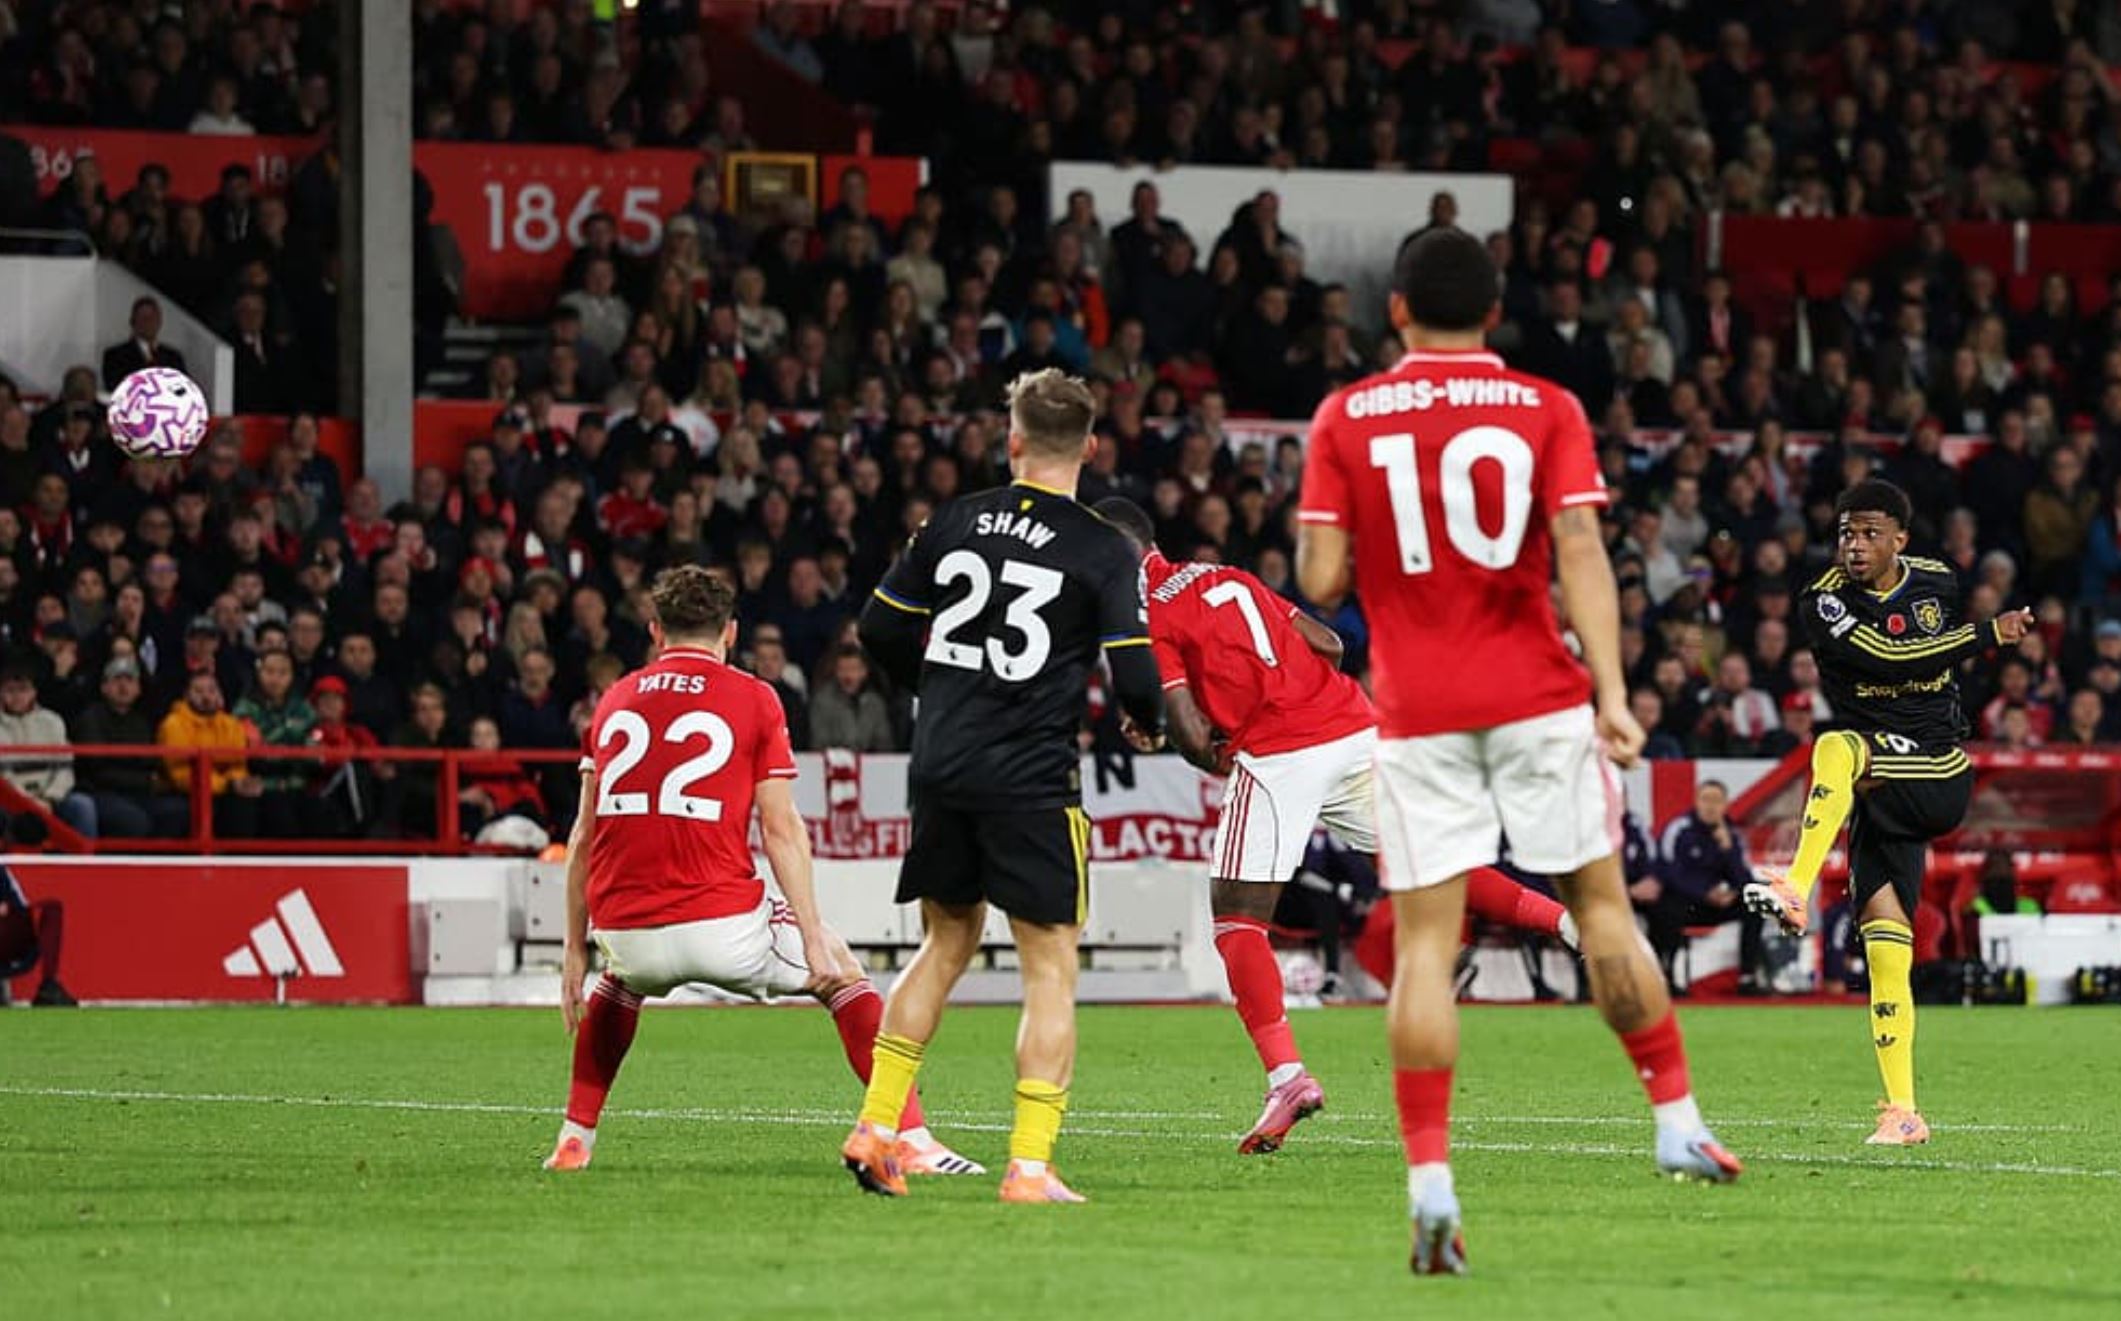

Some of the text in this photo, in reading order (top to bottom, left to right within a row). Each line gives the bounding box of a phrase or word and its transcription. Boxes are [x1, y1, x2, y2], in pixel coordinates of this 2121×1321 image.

[484, 184, 663, 254] 1865
[1346, 379, 1541, 418] GIBBS-WHITE
[976, 512, 1056, 549] SHAW
[1369, 425, 1534, 575] 10
[924, 550, 1063, 682] 23
[1202, 580, 1278, 668] 7
[637, 672, 706, 694] YATES
[596, 709, 734, 822] 22
